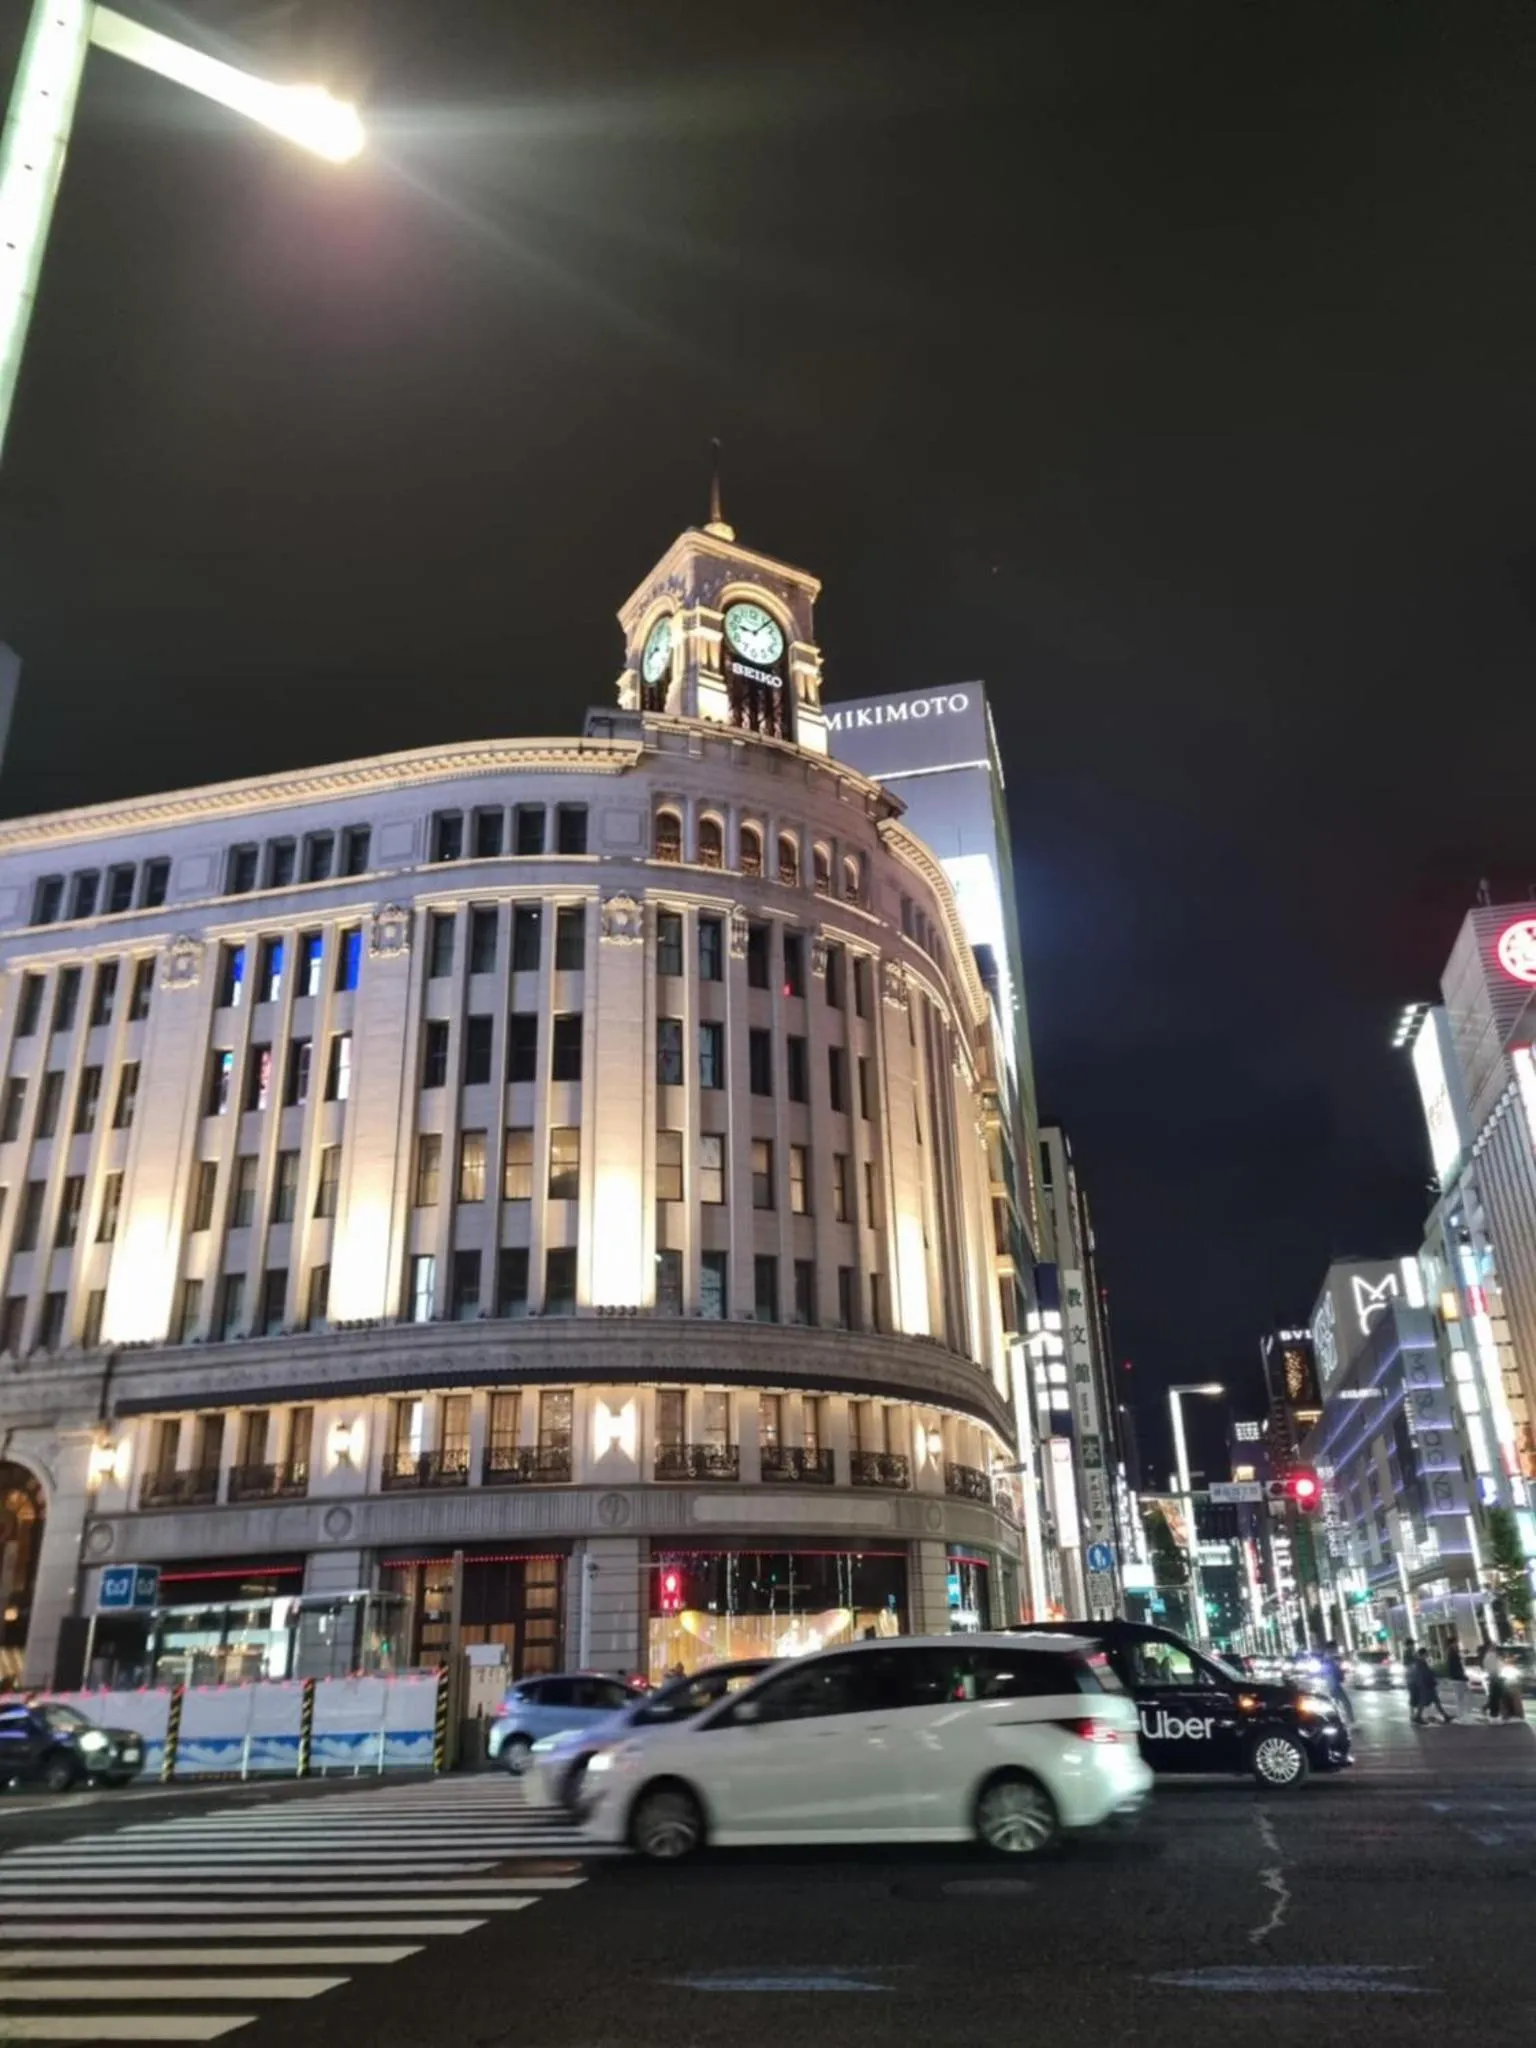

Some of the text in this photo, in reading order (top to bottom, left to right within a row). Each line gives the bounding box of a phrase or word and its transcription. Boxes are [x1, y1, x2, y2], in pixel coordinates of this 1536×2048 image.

[732, 662, 782, 688] SEIKO
[823, 692, 970, 732] MIKIMOTO
[1141, 1710, 1215, 1739] Uber
